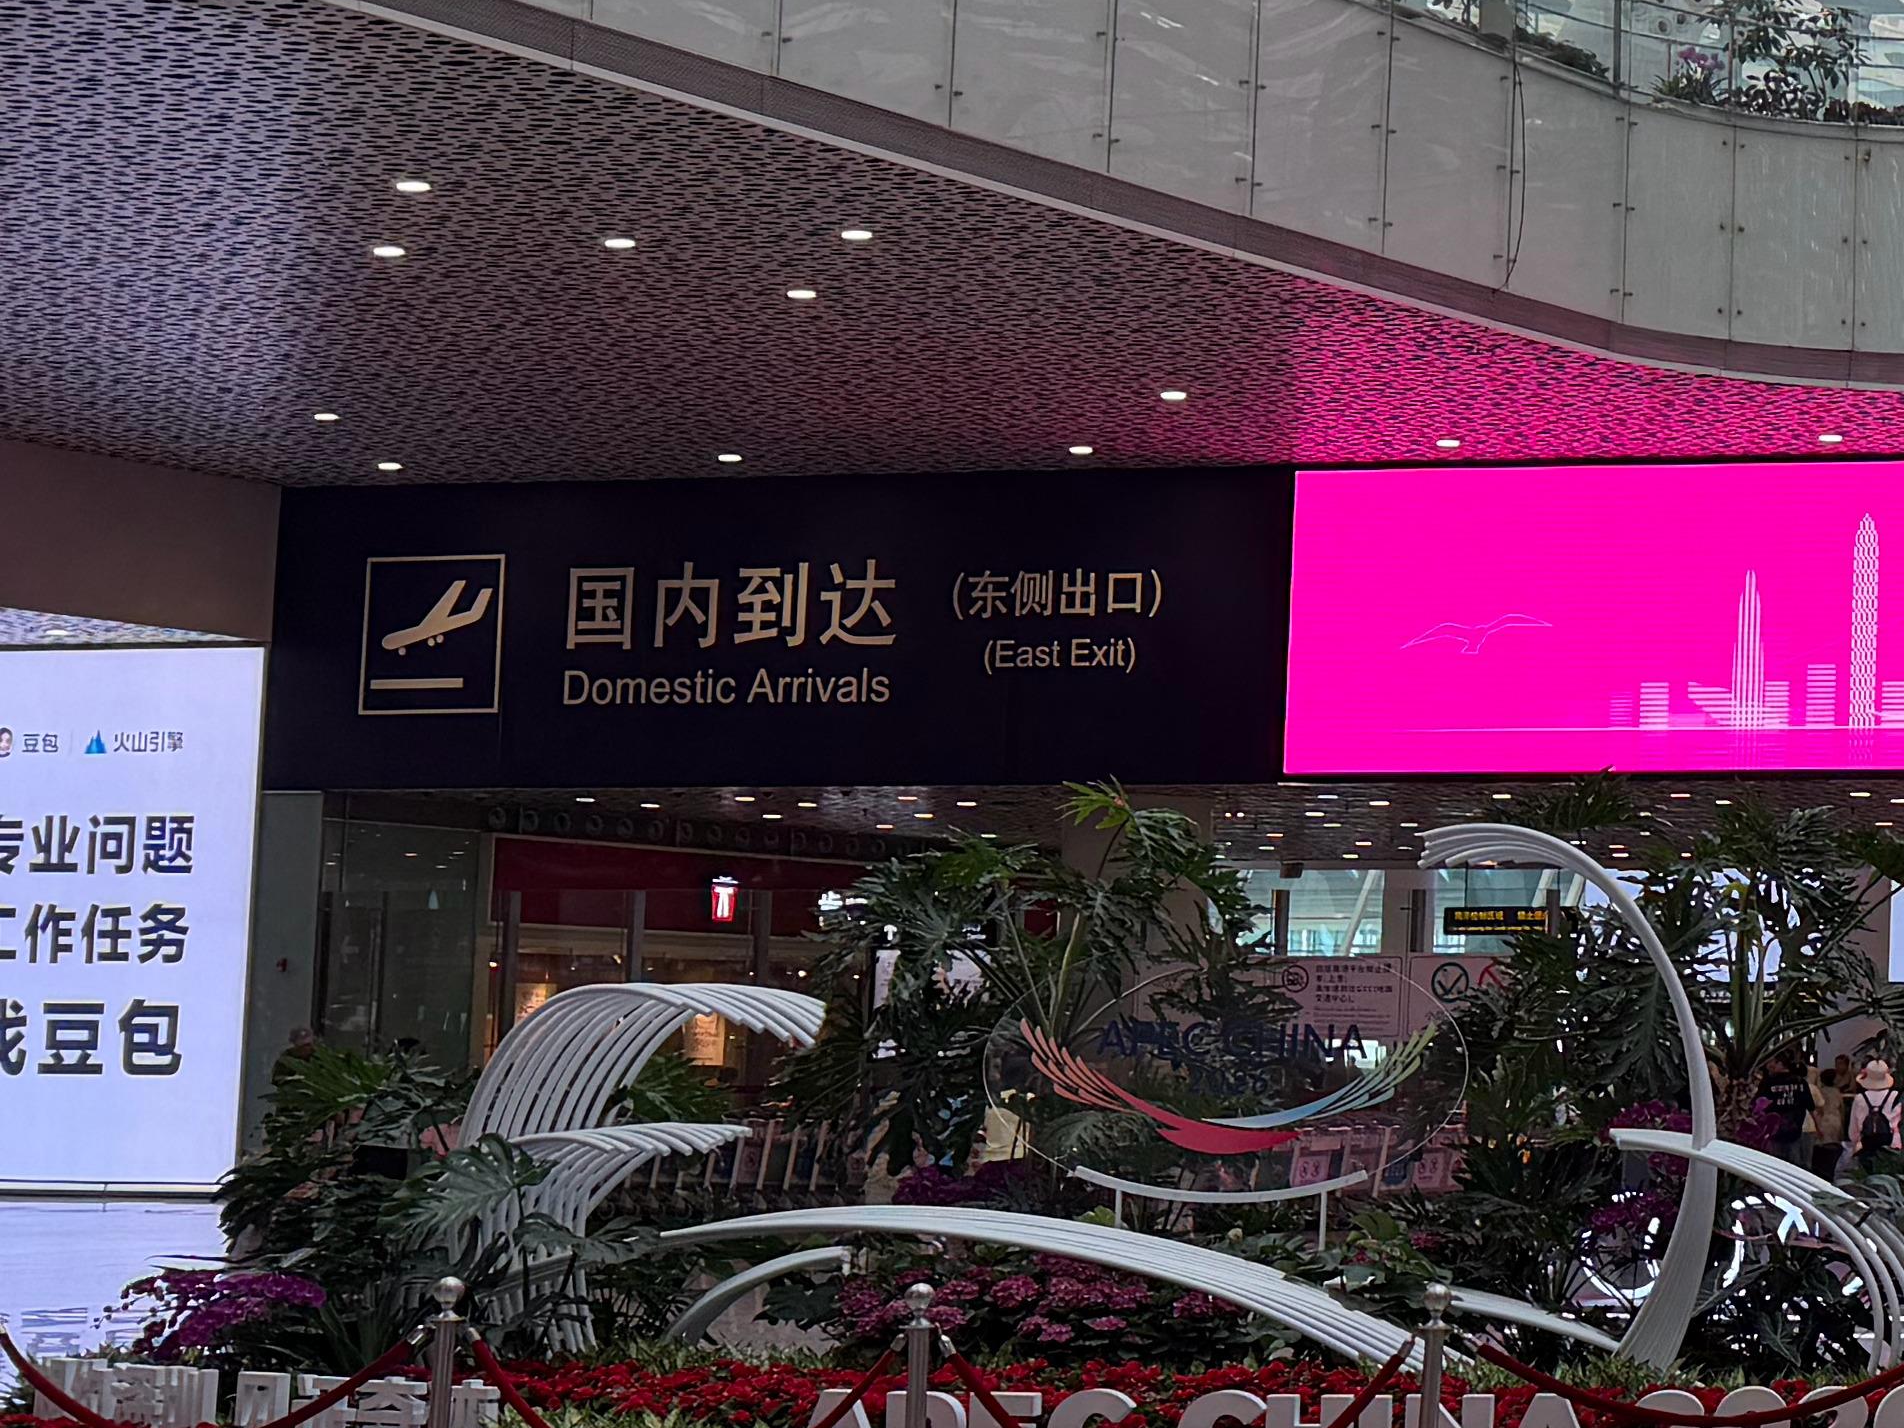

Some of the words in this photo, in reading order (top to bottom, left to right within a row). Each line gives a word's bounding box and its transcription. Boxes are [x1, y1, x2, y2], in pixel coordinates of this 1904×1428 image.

[565, 558, 898, 652] 国内到达
[951, 569, 1163, 621] (东侧出口)
[983, 636, 1064, 675] (East
[1070, 635, 1137, 674] Exit)
[562, 669, 736, 706] Domestic
[746, 666, 891, 705] Arrivals
[22, 732, 59, 754] 豆包
[113, 731, 184, 753] 火山引擎
